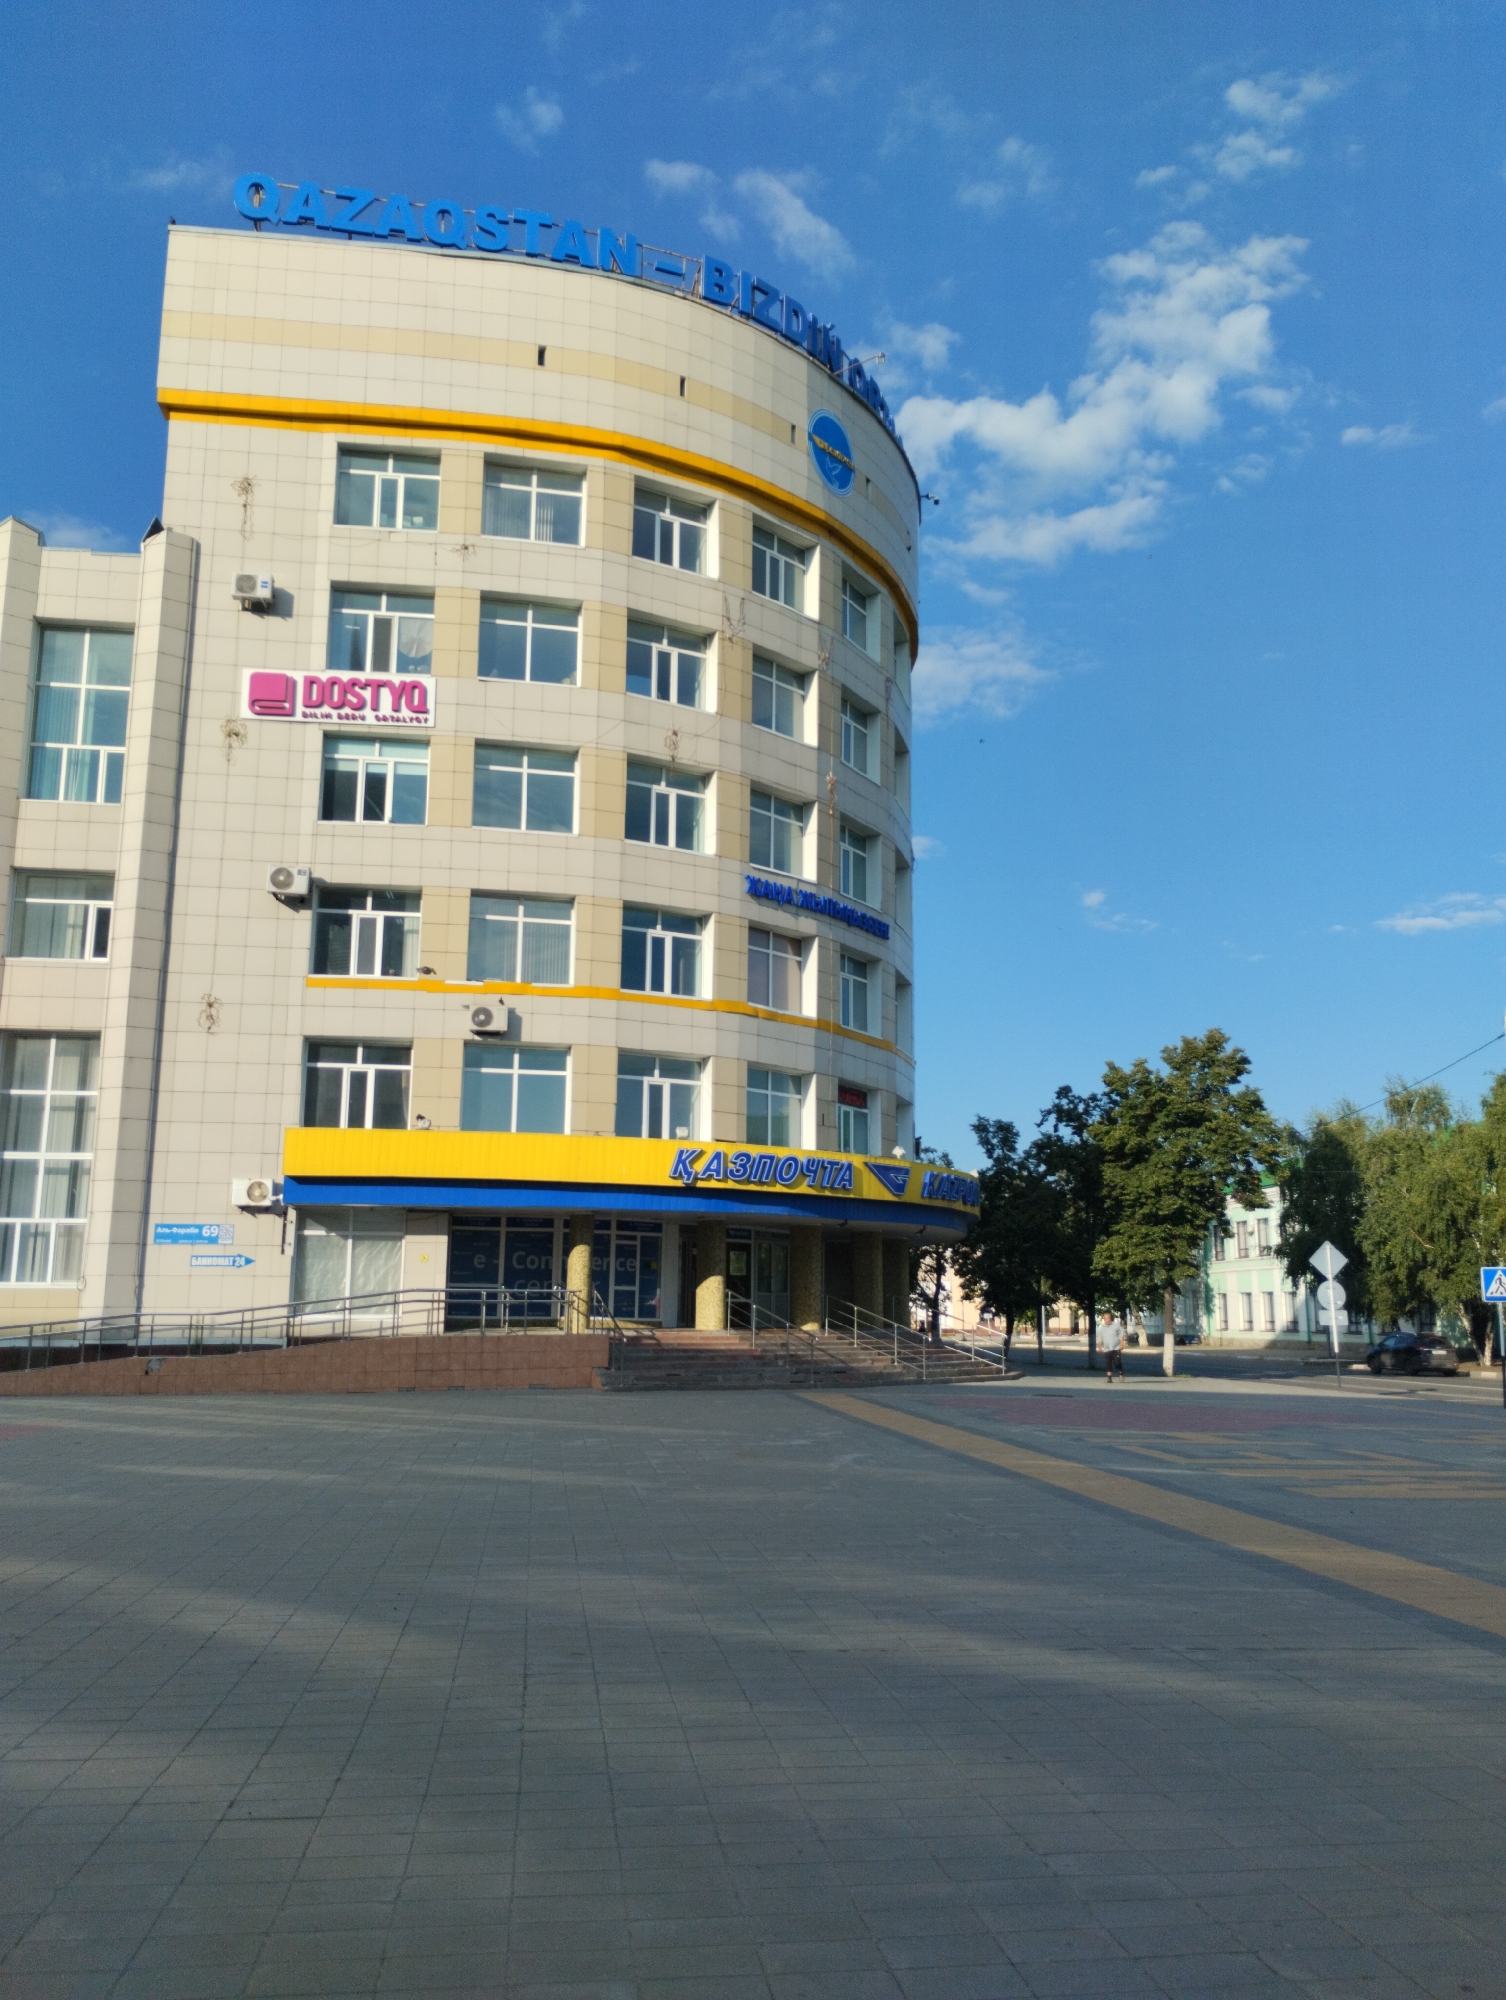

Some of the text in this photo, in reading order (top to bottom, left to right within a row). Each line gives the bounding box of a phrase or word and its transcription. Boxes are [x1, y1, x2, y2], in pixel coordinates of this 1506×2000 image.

[233, 172, 637, 277] QAZAQSTAN
[303, 675, 428, 713] DOSTYQ
[745, 874, 795, 905] ЖАҢА
[669, 1147, 854, 1190] ҚАЗПОЧТА
[156, 1226, 218, 1236] Аль-Фараби 69
[191, 1256, 246, 1267] БАНКОМАТ 24
